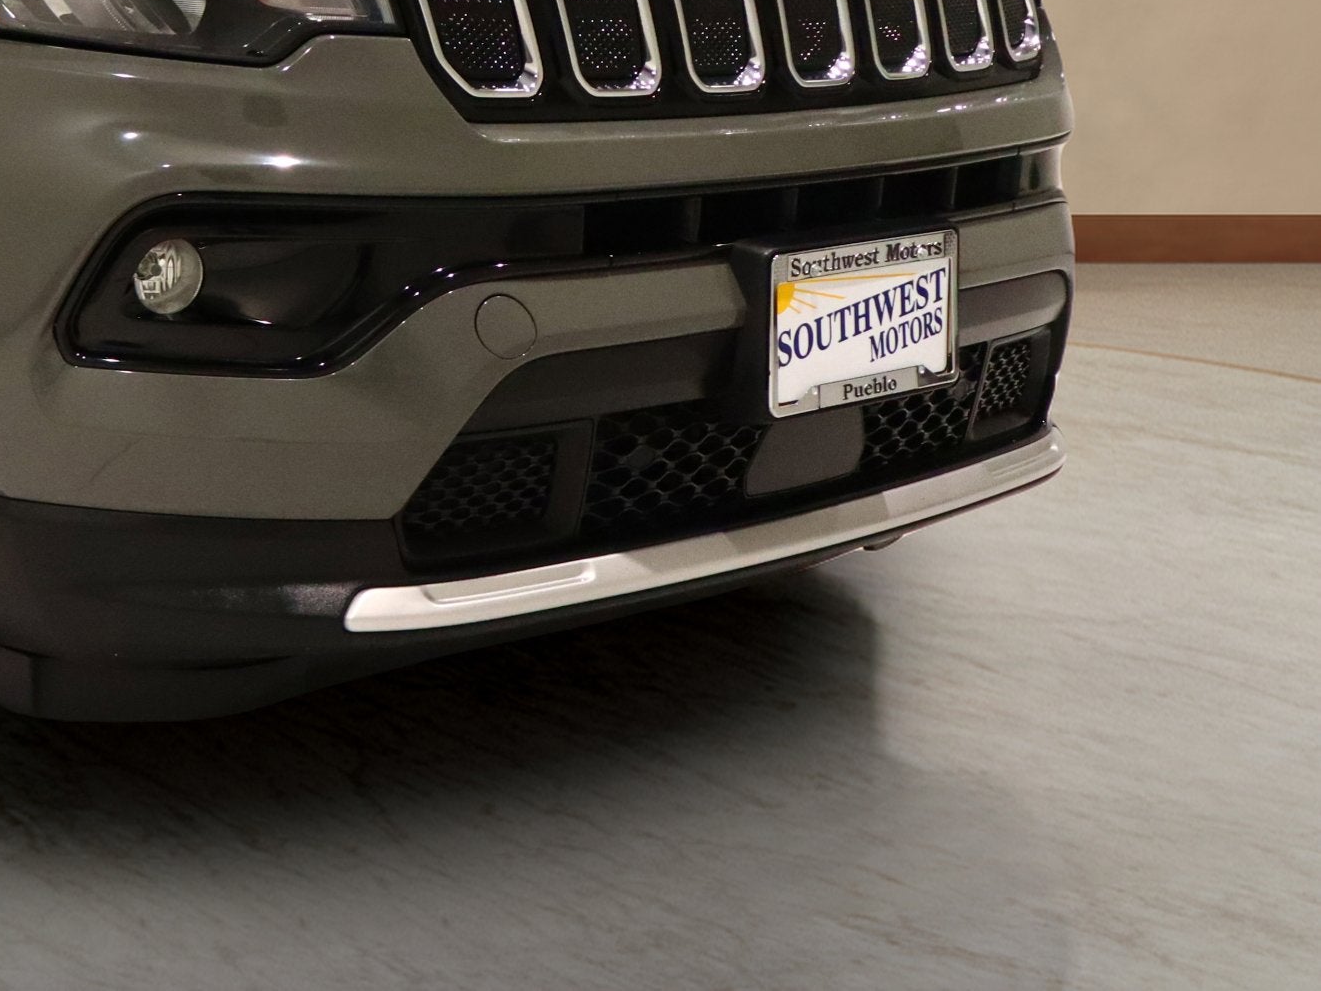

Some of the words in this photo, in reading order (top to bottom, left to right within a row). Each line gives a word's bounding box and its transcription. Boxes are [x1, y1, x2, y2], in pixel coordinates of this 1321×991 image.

[885, 241, 943, 263] Motrs
[778, 267, 946, 368] SOUTHWEST
[869, 307, 943, 363] MOTORS
[842, 378, 896, 400] Pueblo
